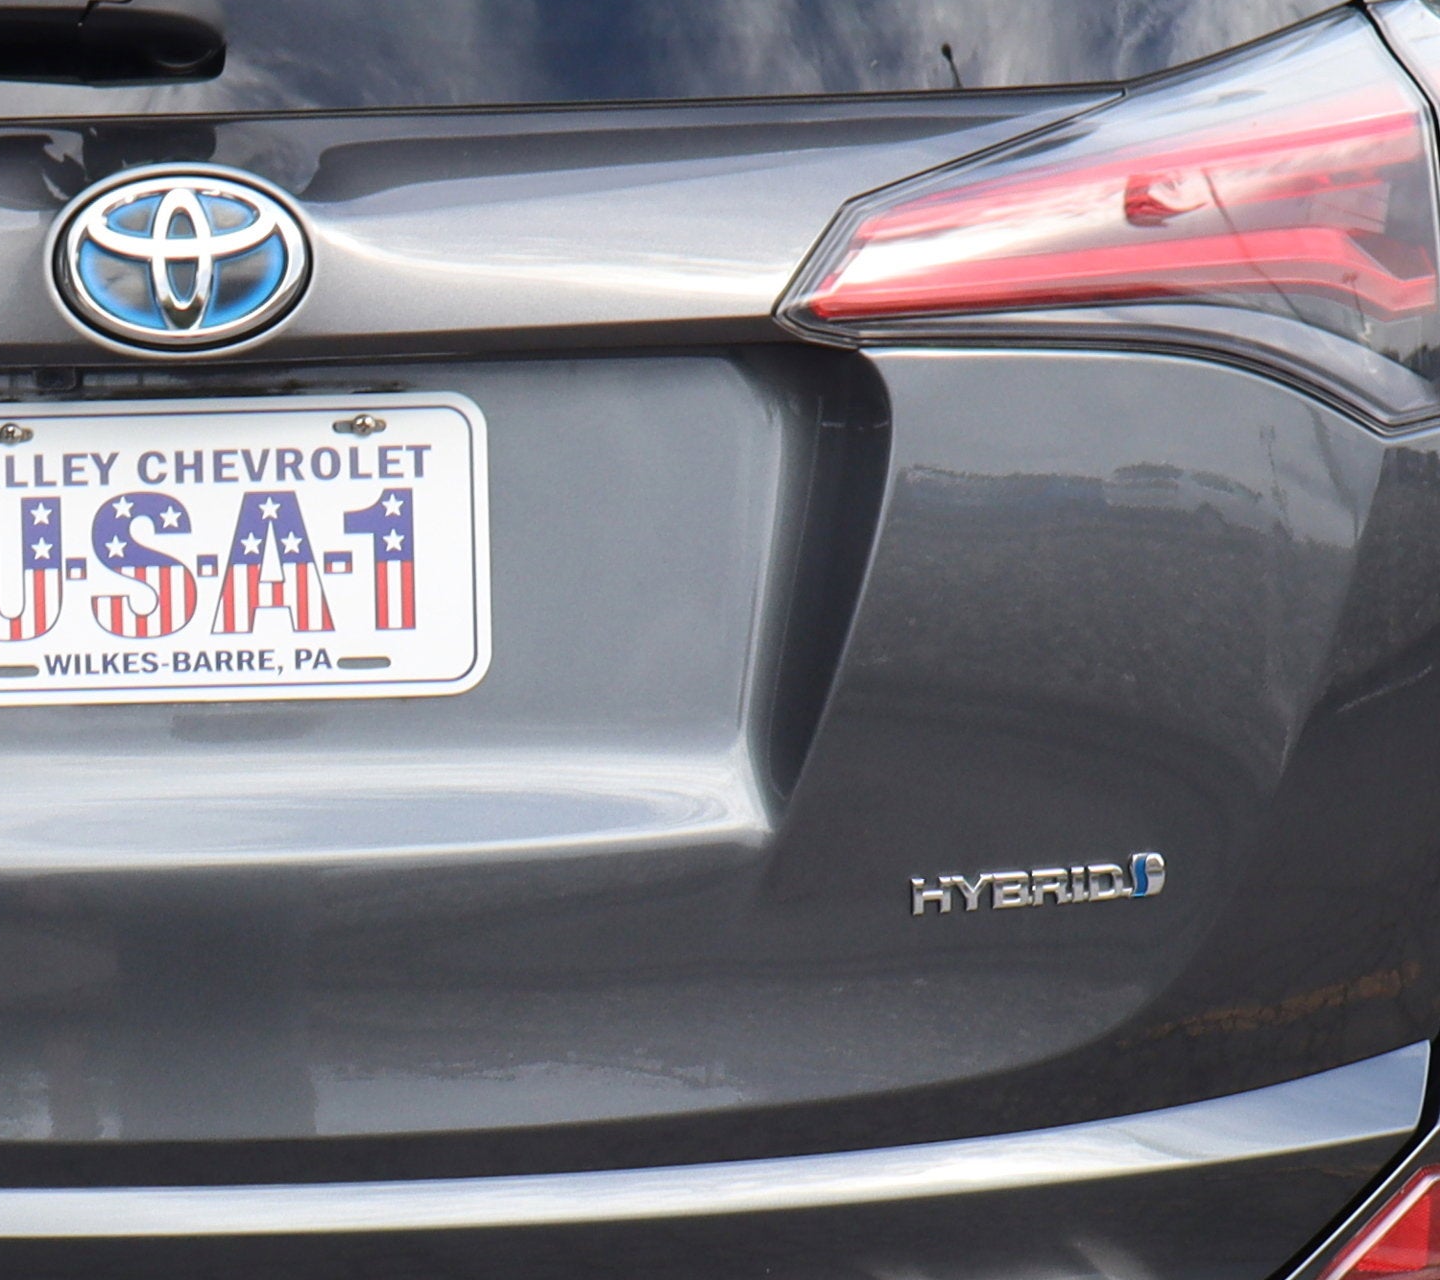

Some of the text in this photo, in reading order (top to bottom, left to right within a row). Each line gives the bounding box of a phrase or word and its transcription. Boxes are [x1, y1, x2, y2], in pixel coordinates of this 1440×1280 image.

[136, 444, 432, 485] CHEVROLET
[45, 649, 333, 677] WILKES-BARRE, PA
[911, 863, 1132, 916] HYBRID
